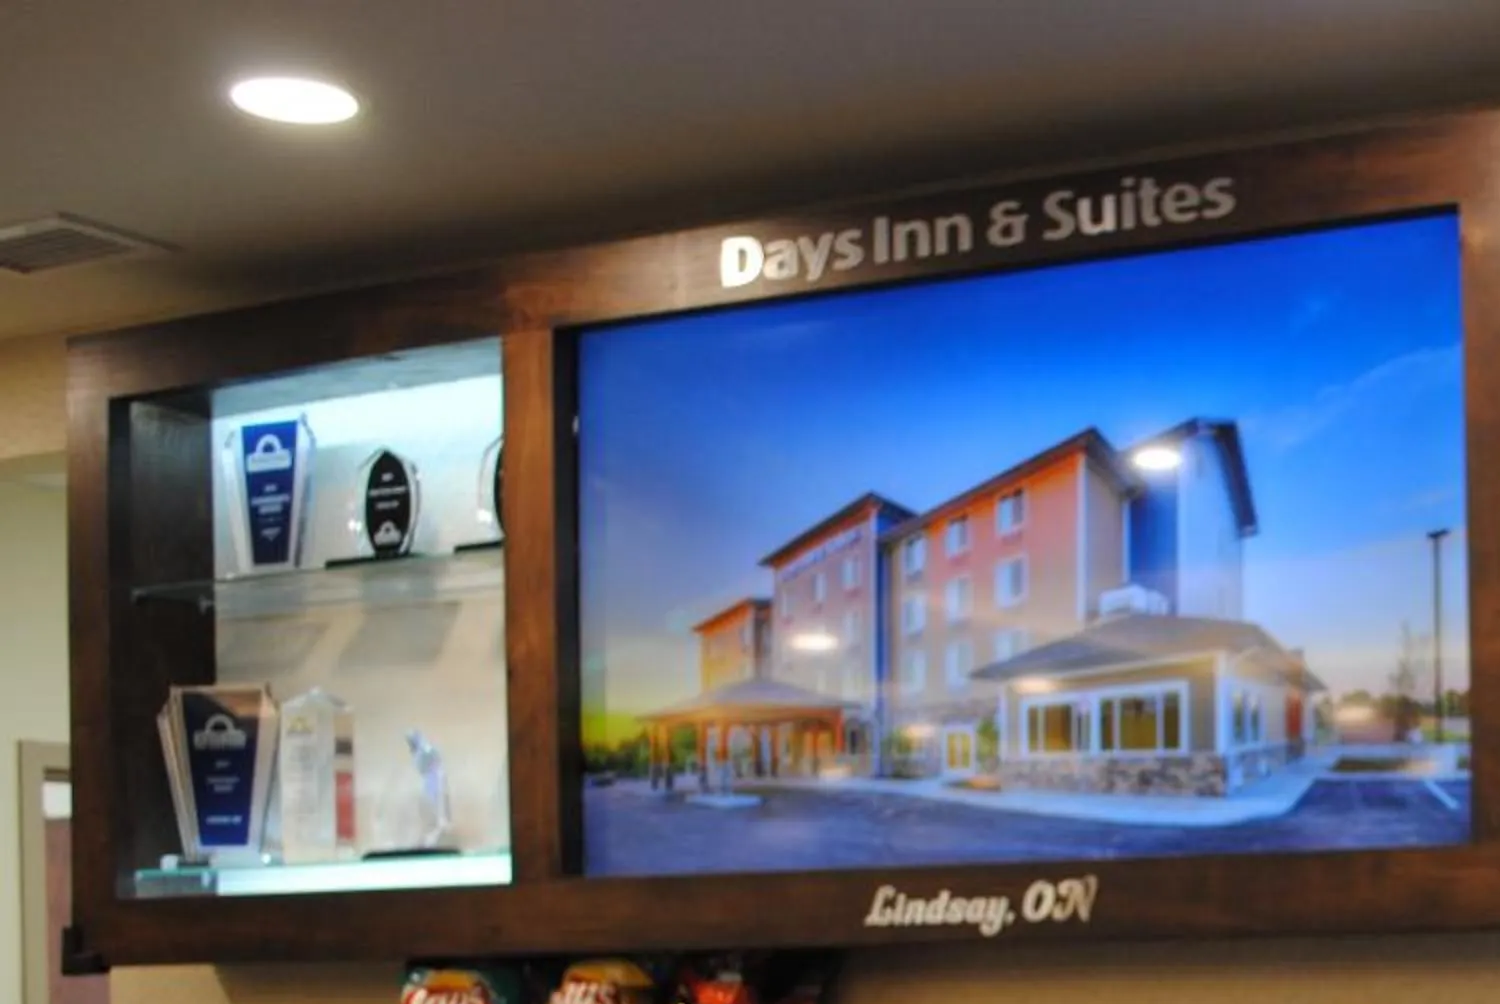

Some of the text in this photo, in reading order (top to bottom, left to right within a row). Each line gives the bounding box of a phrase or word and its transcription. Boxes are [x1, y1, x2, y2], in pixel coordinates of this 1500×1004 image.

[719, 176, 1237, 289] Days Inn & Suites
[1022, 875, 1098, 923] ON
